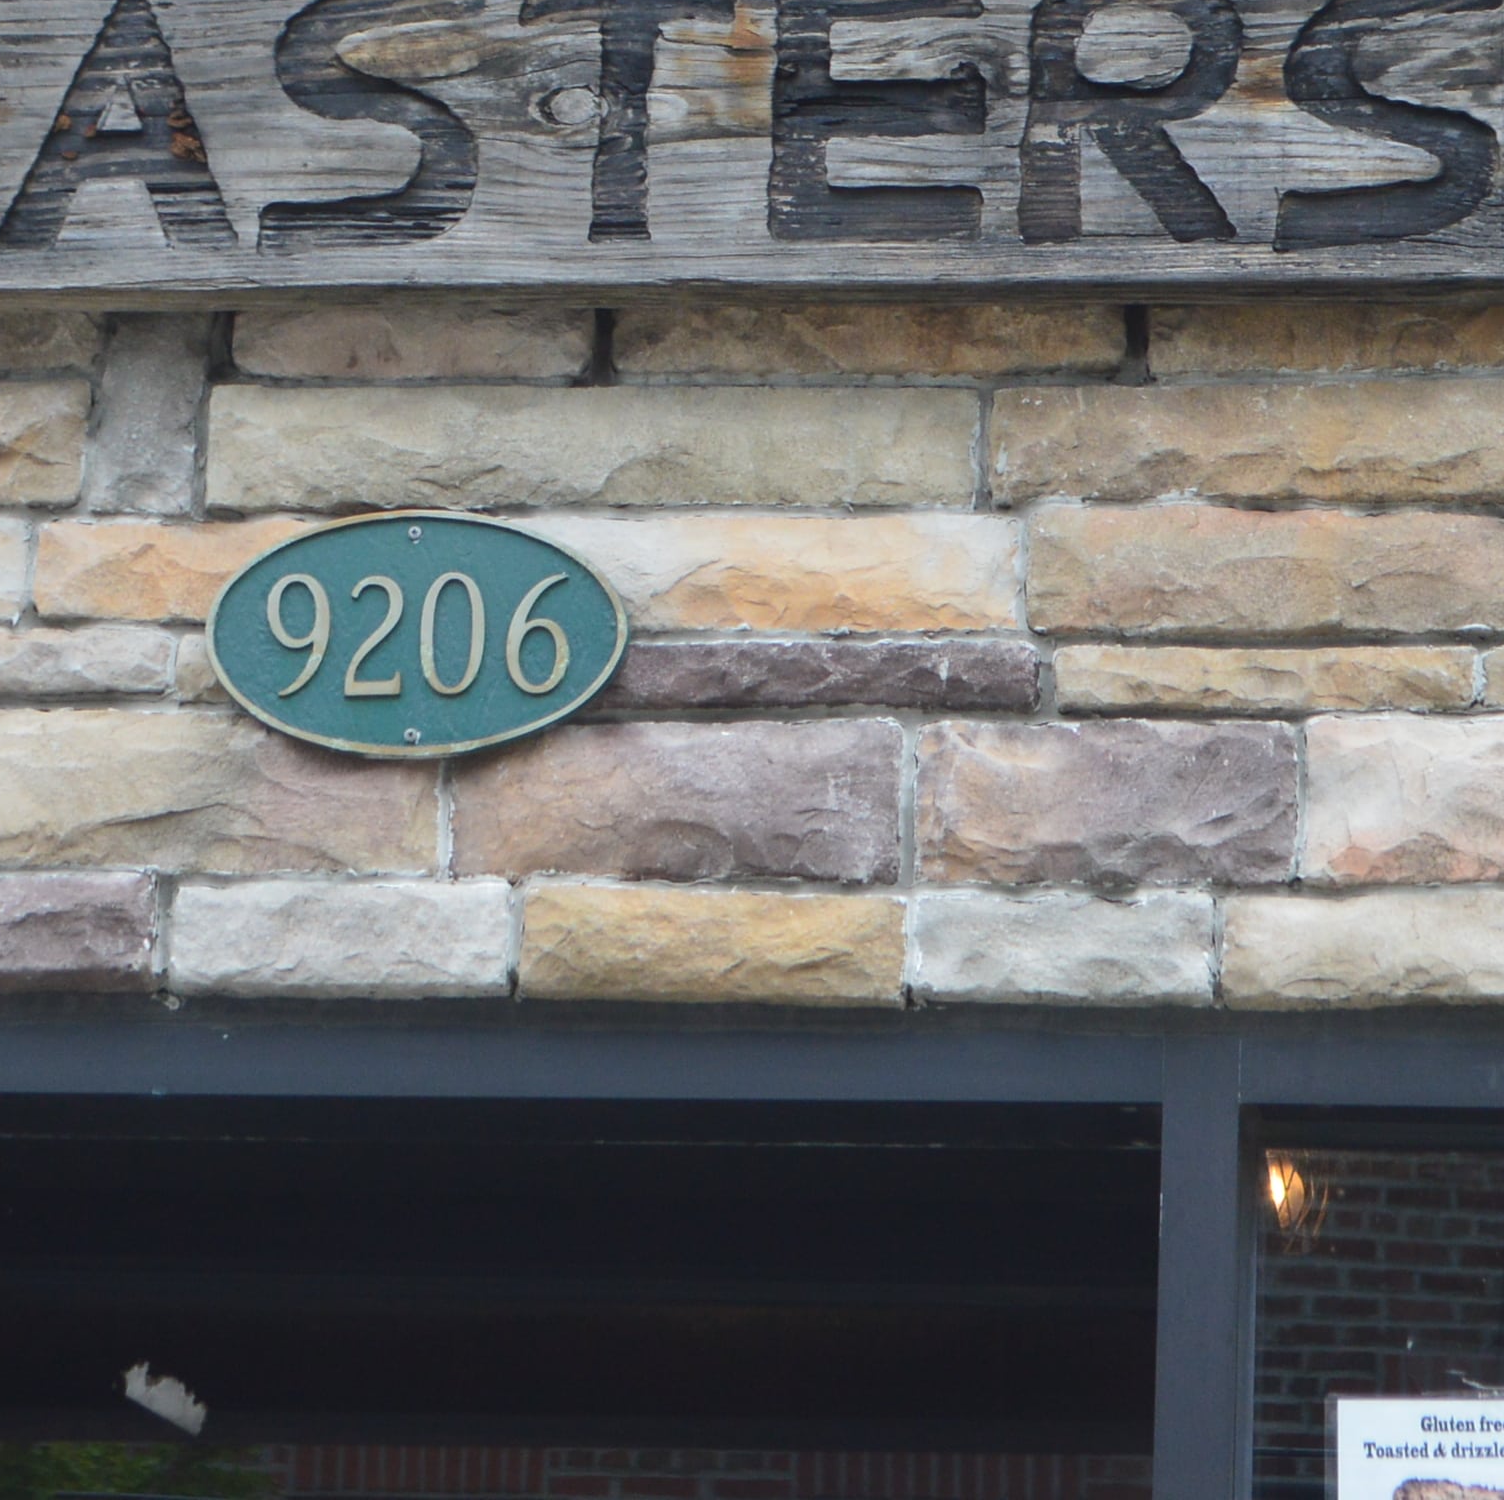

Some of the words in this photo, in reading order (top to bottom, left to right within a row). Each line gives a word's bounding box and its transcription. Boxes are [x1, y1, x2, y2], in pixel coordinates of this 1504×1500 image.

[266, 571, 571, 697] 9206
[1420, 1415, 1475, 1433] Gluten
[1363, 1441, 1429, 1459] Toasted
[1433, 1443, 1447, 1459] &
